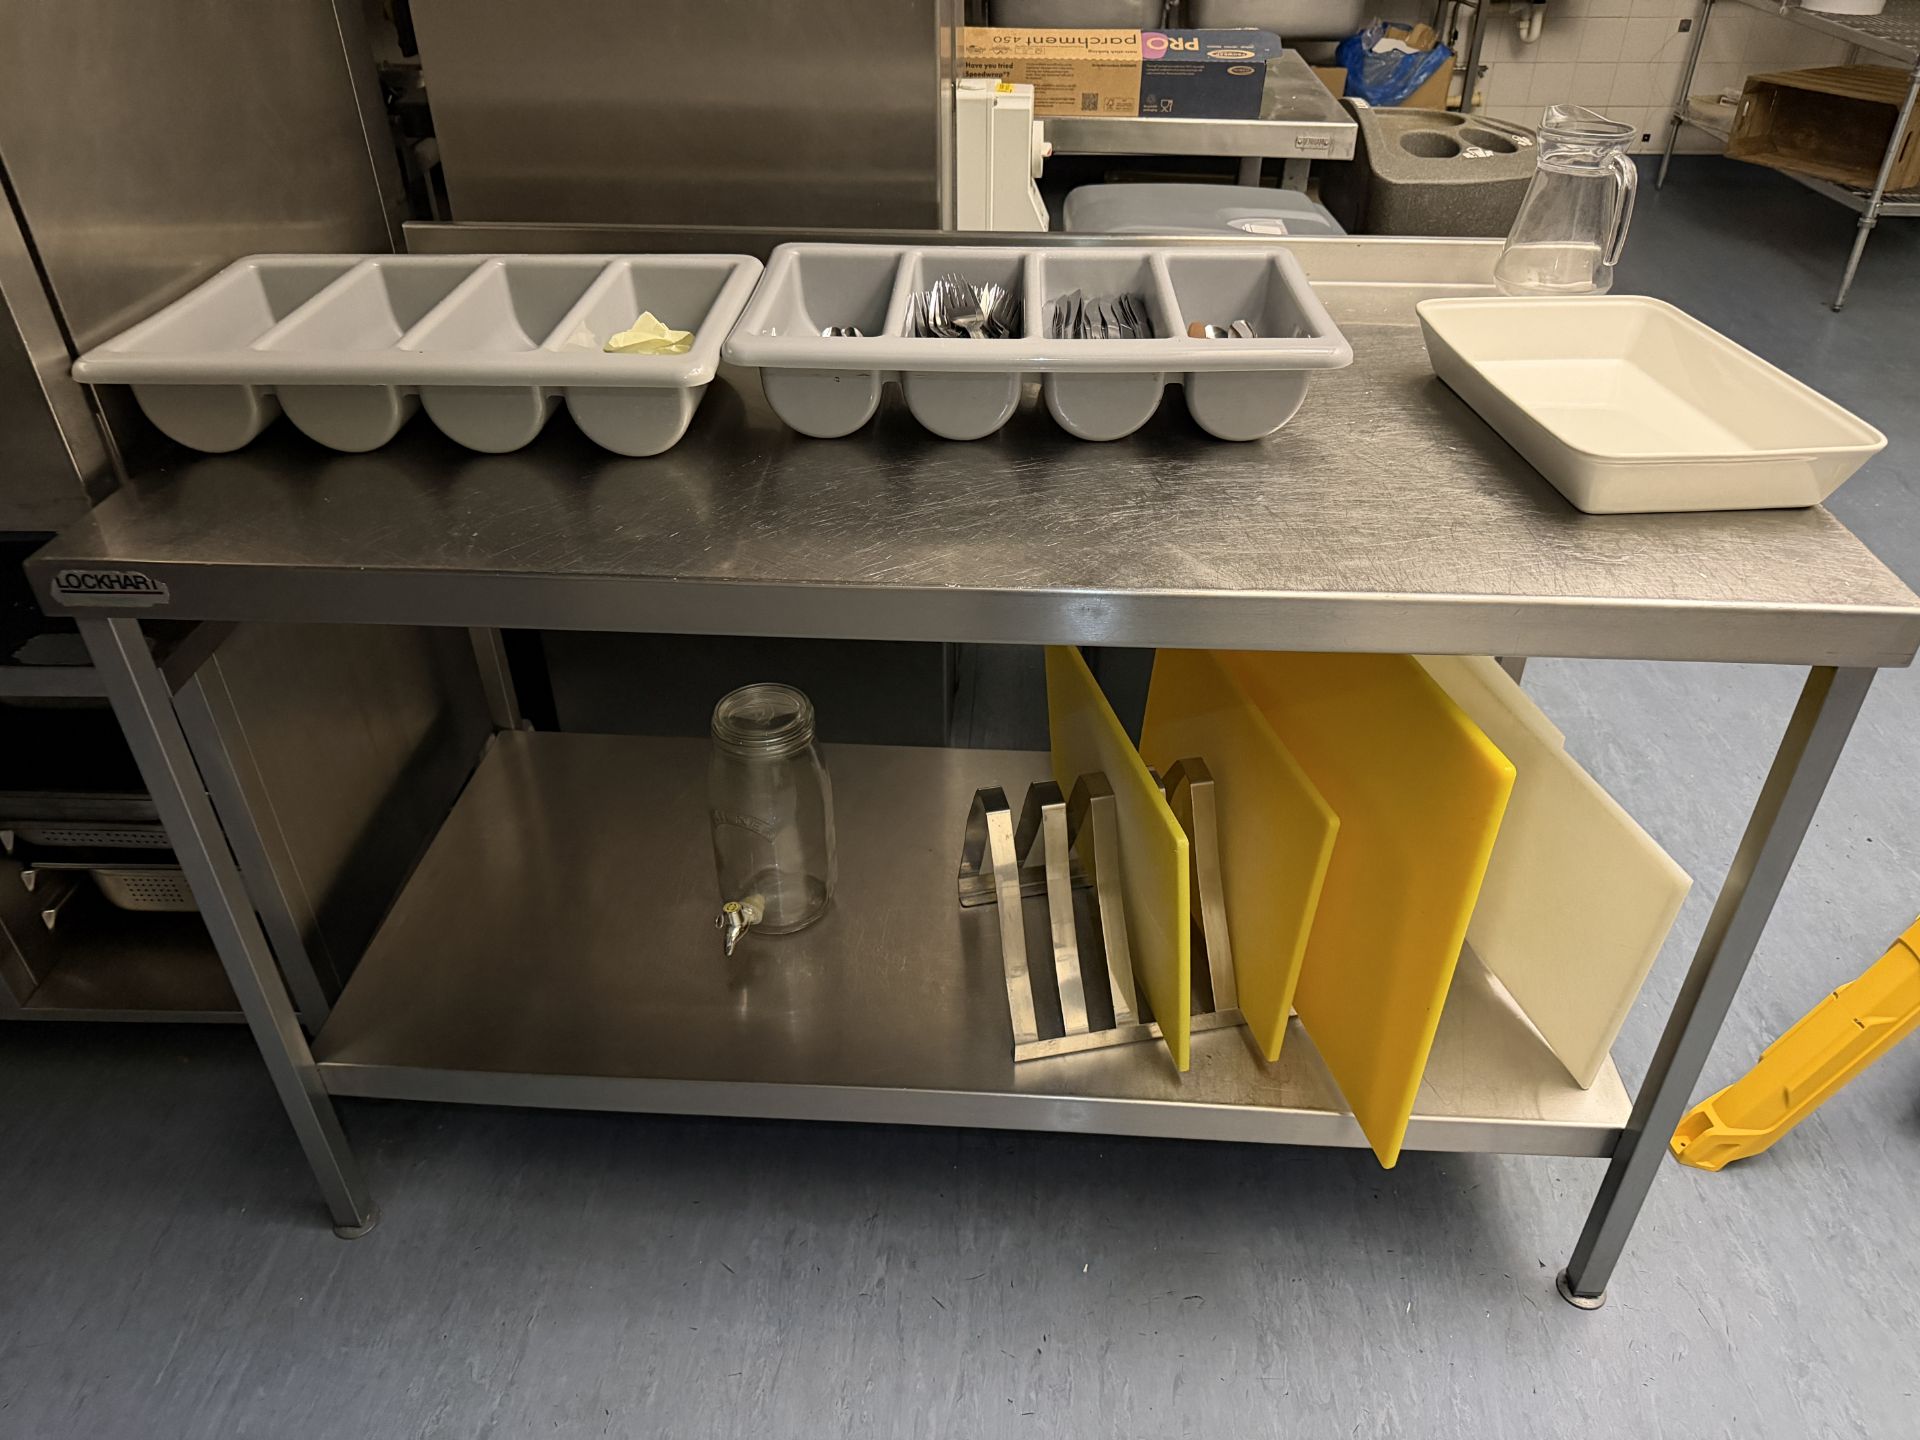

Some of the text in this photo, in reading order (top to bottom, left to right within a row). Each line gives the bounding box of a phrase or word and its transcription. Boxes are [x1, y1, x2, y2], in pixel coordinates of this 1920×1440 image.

[993, 35, 1200, 51] PRO parchment 450
[966, 61, 1013, 70] Have you tried
